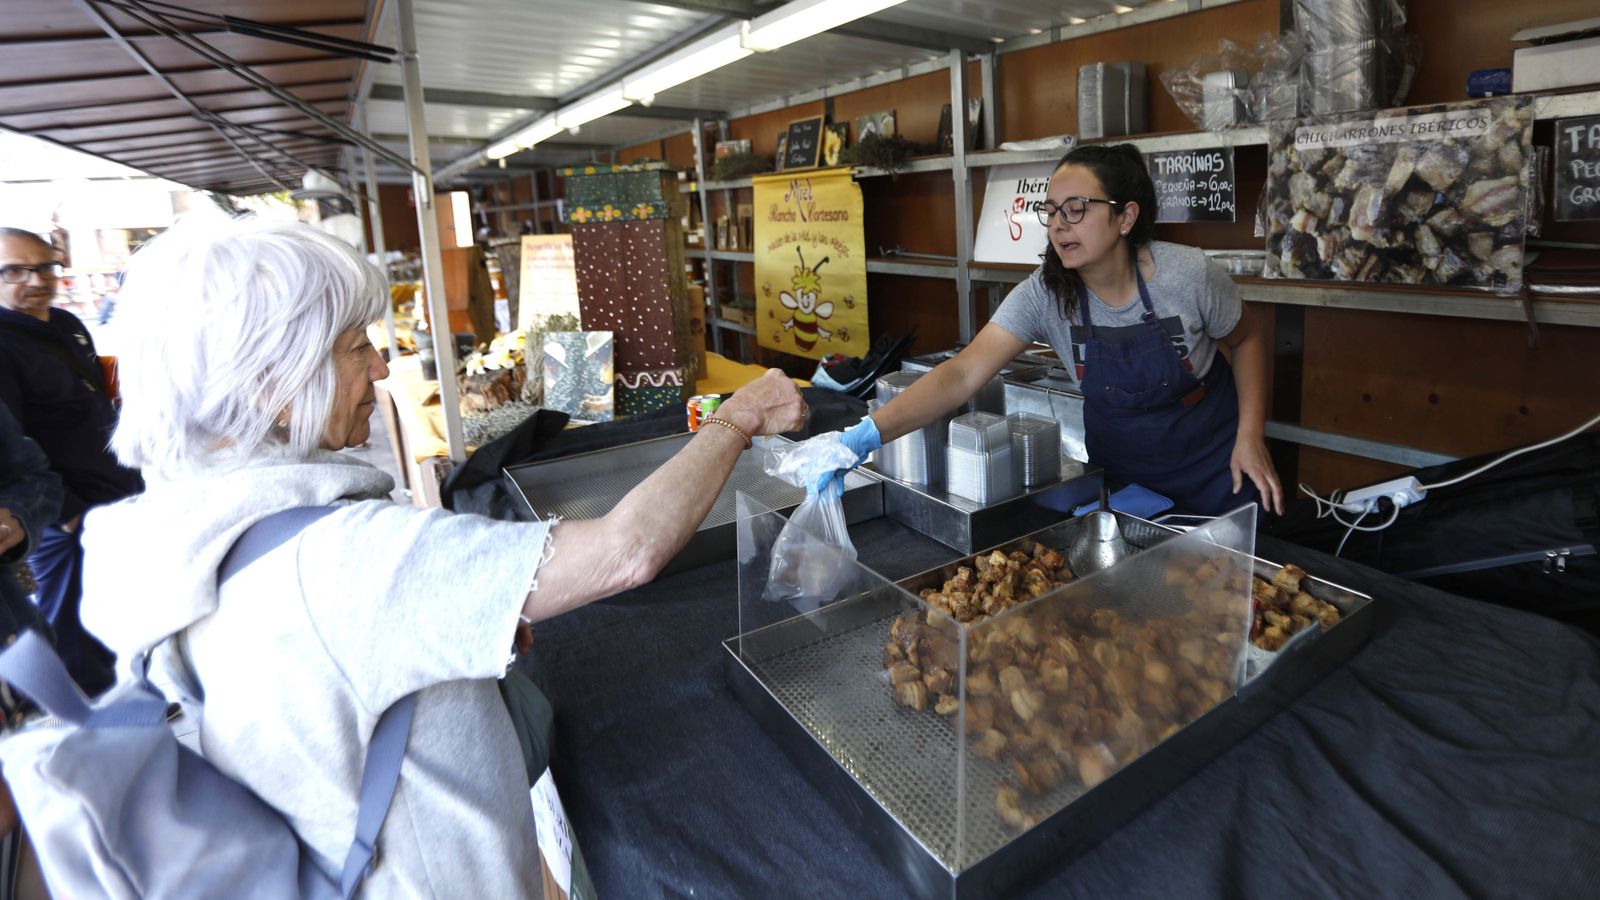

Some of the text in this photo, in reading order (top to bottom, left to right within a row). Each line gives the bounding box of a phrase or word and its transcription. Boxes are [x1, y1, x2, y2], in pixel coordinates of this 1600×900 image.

[1409, 116, 1489, 135] IBÉRICOS
[1155, 179, 1195, 193] PEQUEÑA
[1157, 196, 1198, 209] GRANDE
[768, 203, 796, 222] Rancho
